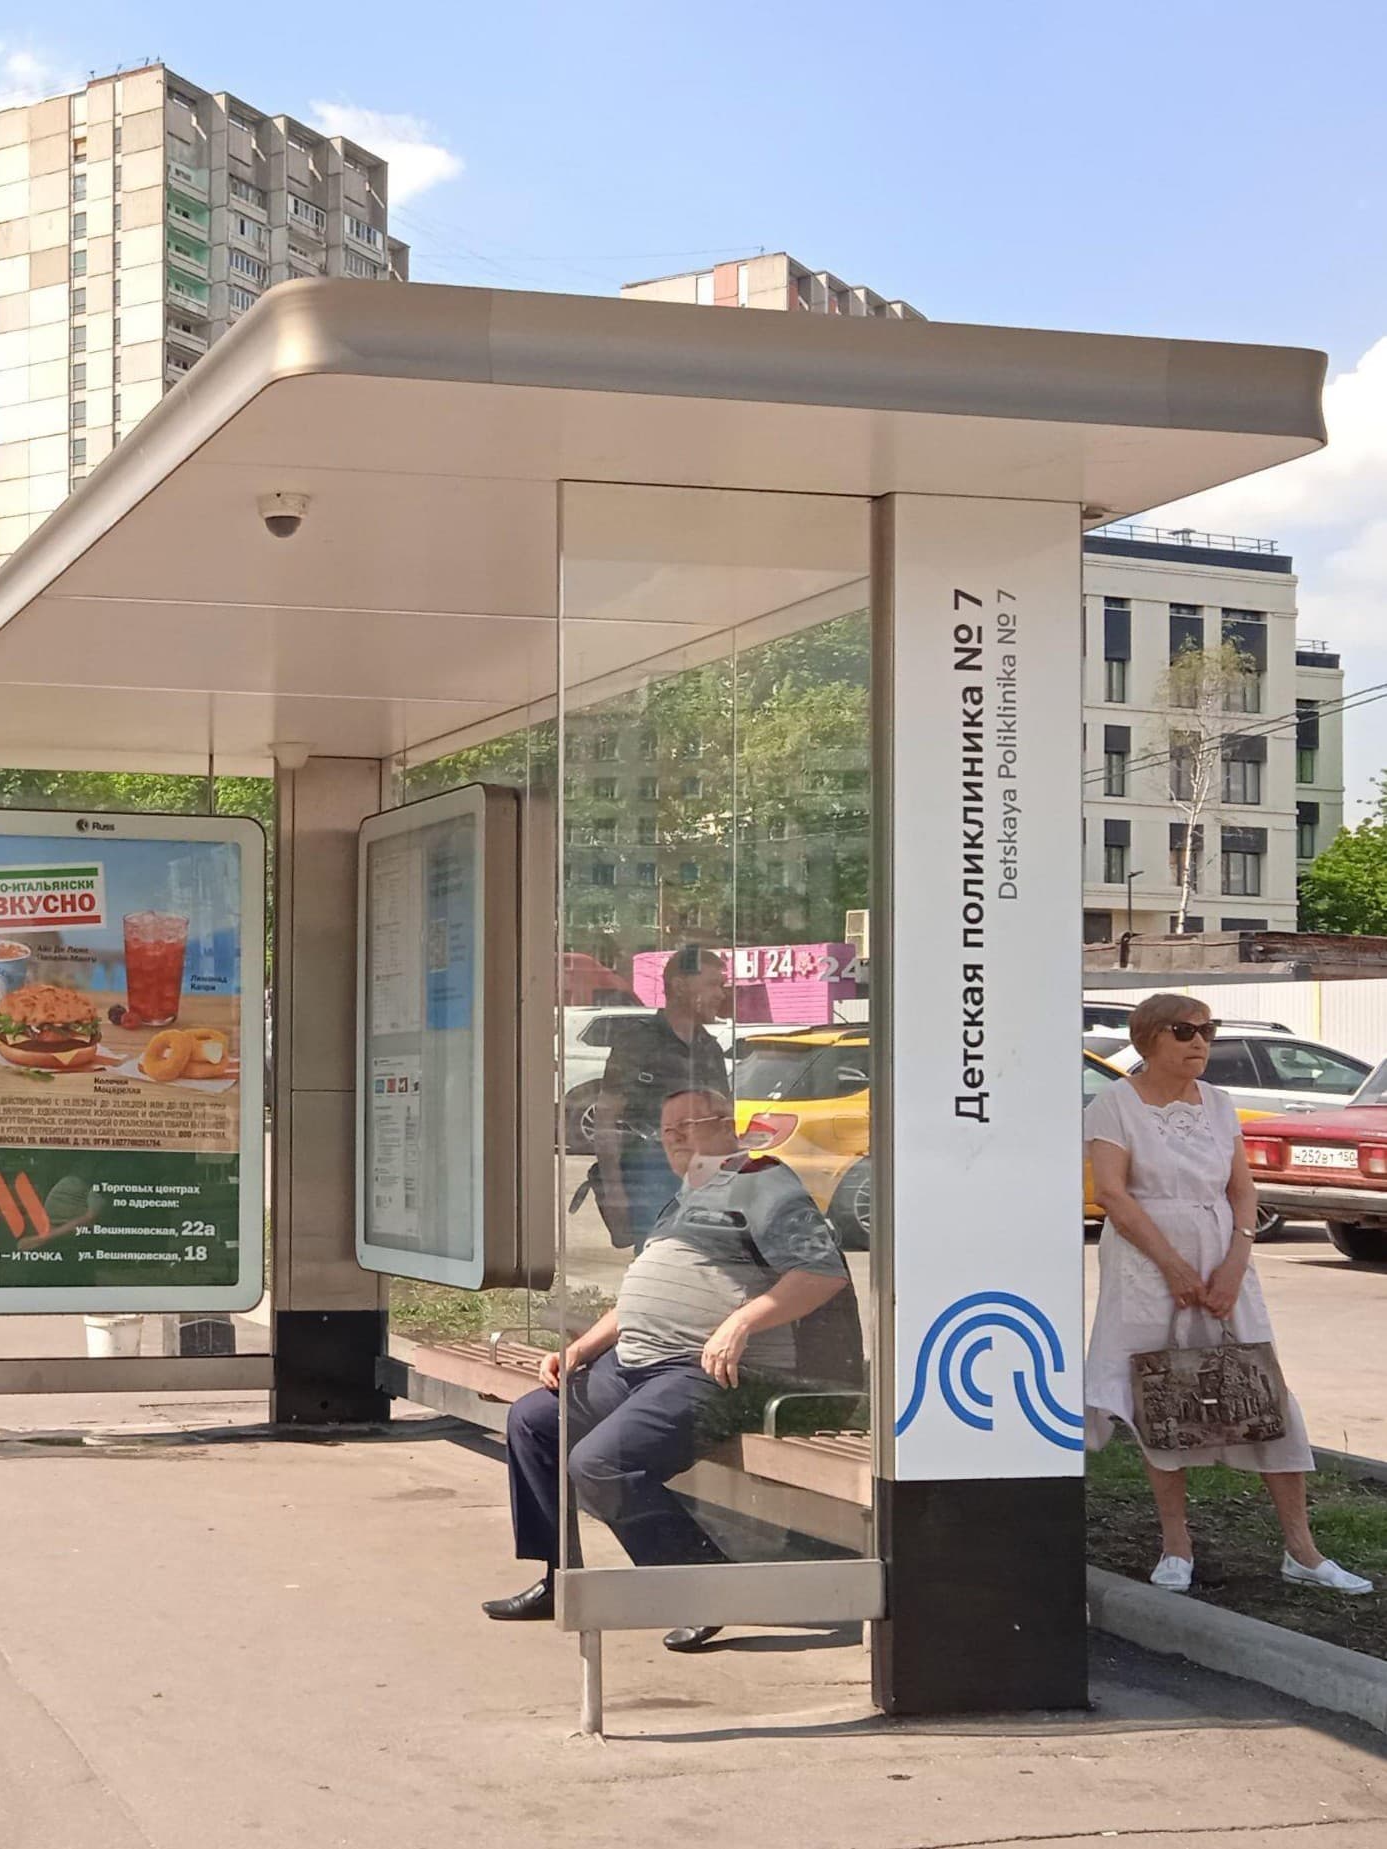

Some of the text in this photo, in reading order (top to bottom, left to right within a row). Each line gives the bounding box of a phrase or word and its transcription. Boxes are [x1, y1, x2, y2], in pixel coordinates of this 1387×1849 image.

[997, 589, 1017, 603] 7
[996, 654, 1017, 779] Poliklinika
[92, 822, 115, 831] Russ
[998, 788, 1022, 900] Detskaya
[954, 588, 990, 1123] Детская поликлиника № 7
[765, 950, 794, 979] 24
[820, 956, 866, 984] 24
[93, 1182, 200, 1195] в Торговых центрах
[113, 1199, 180, 1208] по адресам:
[75, 1221, 215, 1237] ул. Вешняковская, 22а
[12, 1251, 21, 1260] И
[22, 1251, 63, 1261] ТОЧКА
[78, 1245, 208, 1262] ул. Вешняковская, 18
